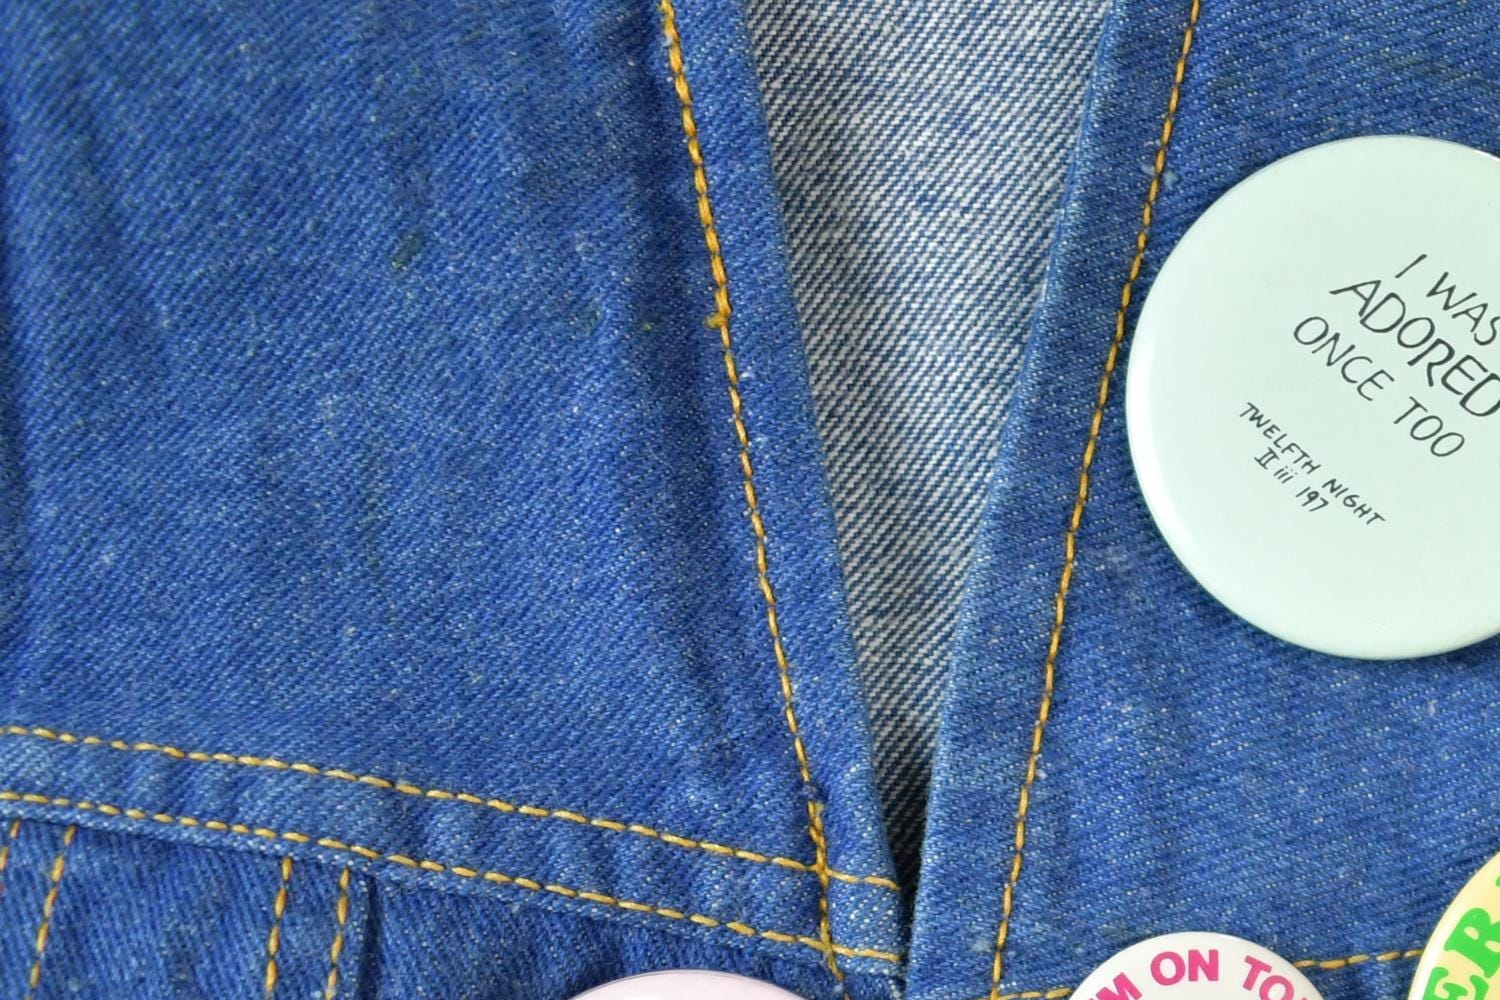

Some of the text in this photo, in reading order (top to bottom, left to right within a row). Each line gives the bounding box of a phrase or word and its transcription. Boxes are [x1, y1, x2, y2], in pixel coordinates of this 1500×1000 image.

[1395, 253, 1428, 279] I
[1293, 316, 1466, 458] ONCE TOO
[1240, 401, 1386, 525] TWELFTH NIGHT
[1254, 446, 1329, 512] II iii 197
[1150, 949, 1219, 986] ON
